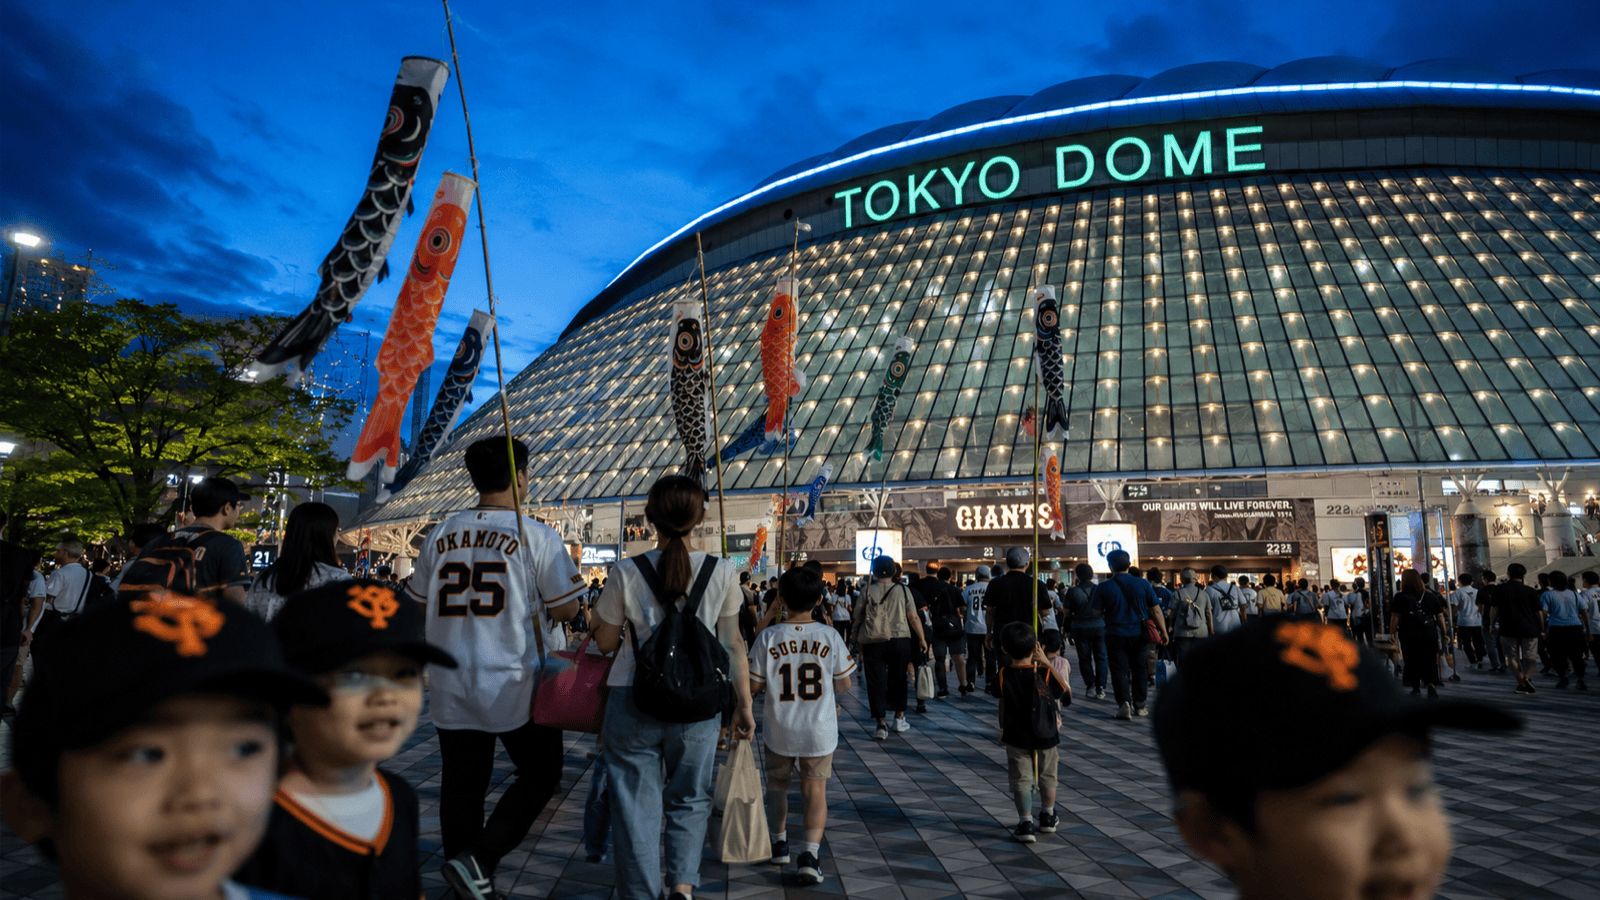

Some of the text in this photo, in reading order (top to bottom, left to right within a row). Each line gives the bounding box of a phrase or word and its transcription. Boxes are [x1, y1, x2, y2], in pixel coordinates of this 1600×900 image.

[834, 125, 1266, 228] TOKYO DOME
[956, 503, 1054, 531] GIANTS
[1142, 501, 1293, 512] OUR GIANTS WILL LIVE FOREVER.
[436, 530, 519, 556] OKAMOTO
[254, 552, 270, 564] 21
[438, 561, 507, 618] 25
[769, 640, 830, 660] SUGANO
[778, 662, 823, 702] 18
